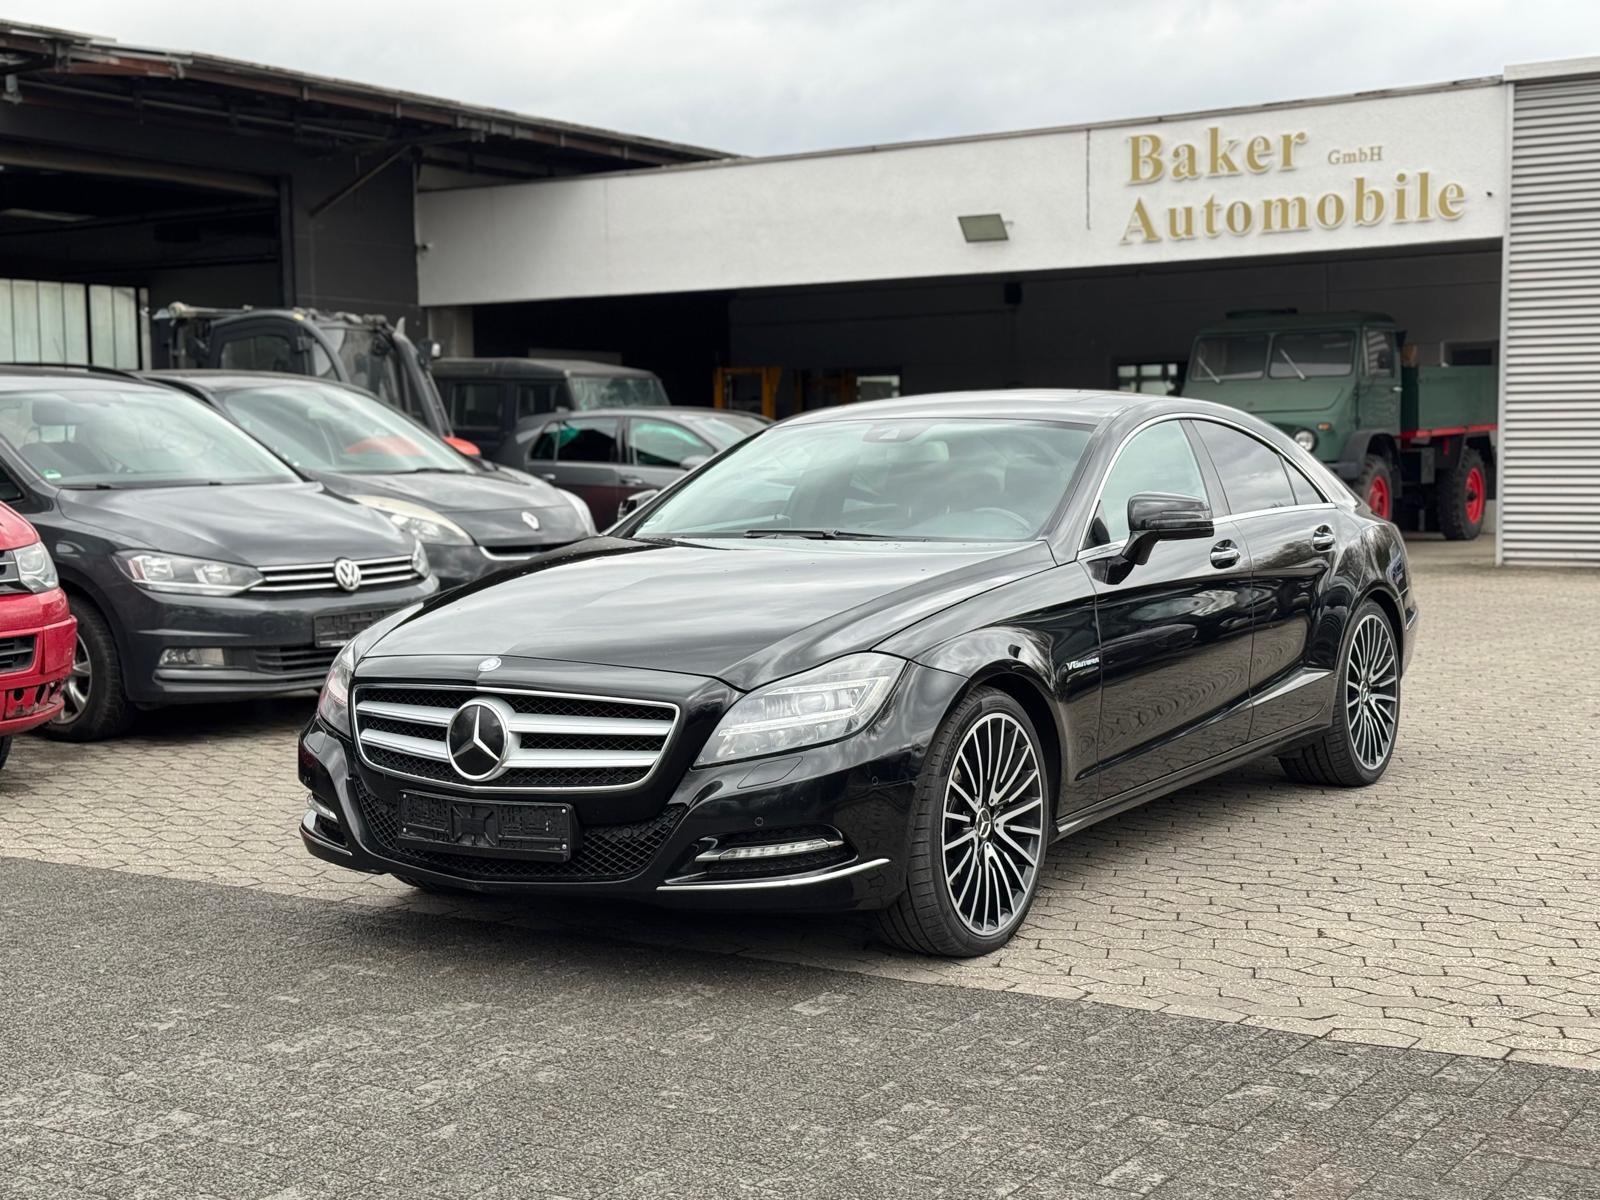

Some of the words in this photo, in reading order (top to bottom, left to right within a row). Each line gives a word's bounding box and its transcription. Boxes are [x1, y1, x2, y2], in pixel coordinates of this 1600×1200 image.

[1127, 127, 1307, 186] Baker
[1327, 145, 1384, 165] GmbH
[1119, 172, 1466, 245] Automobile
